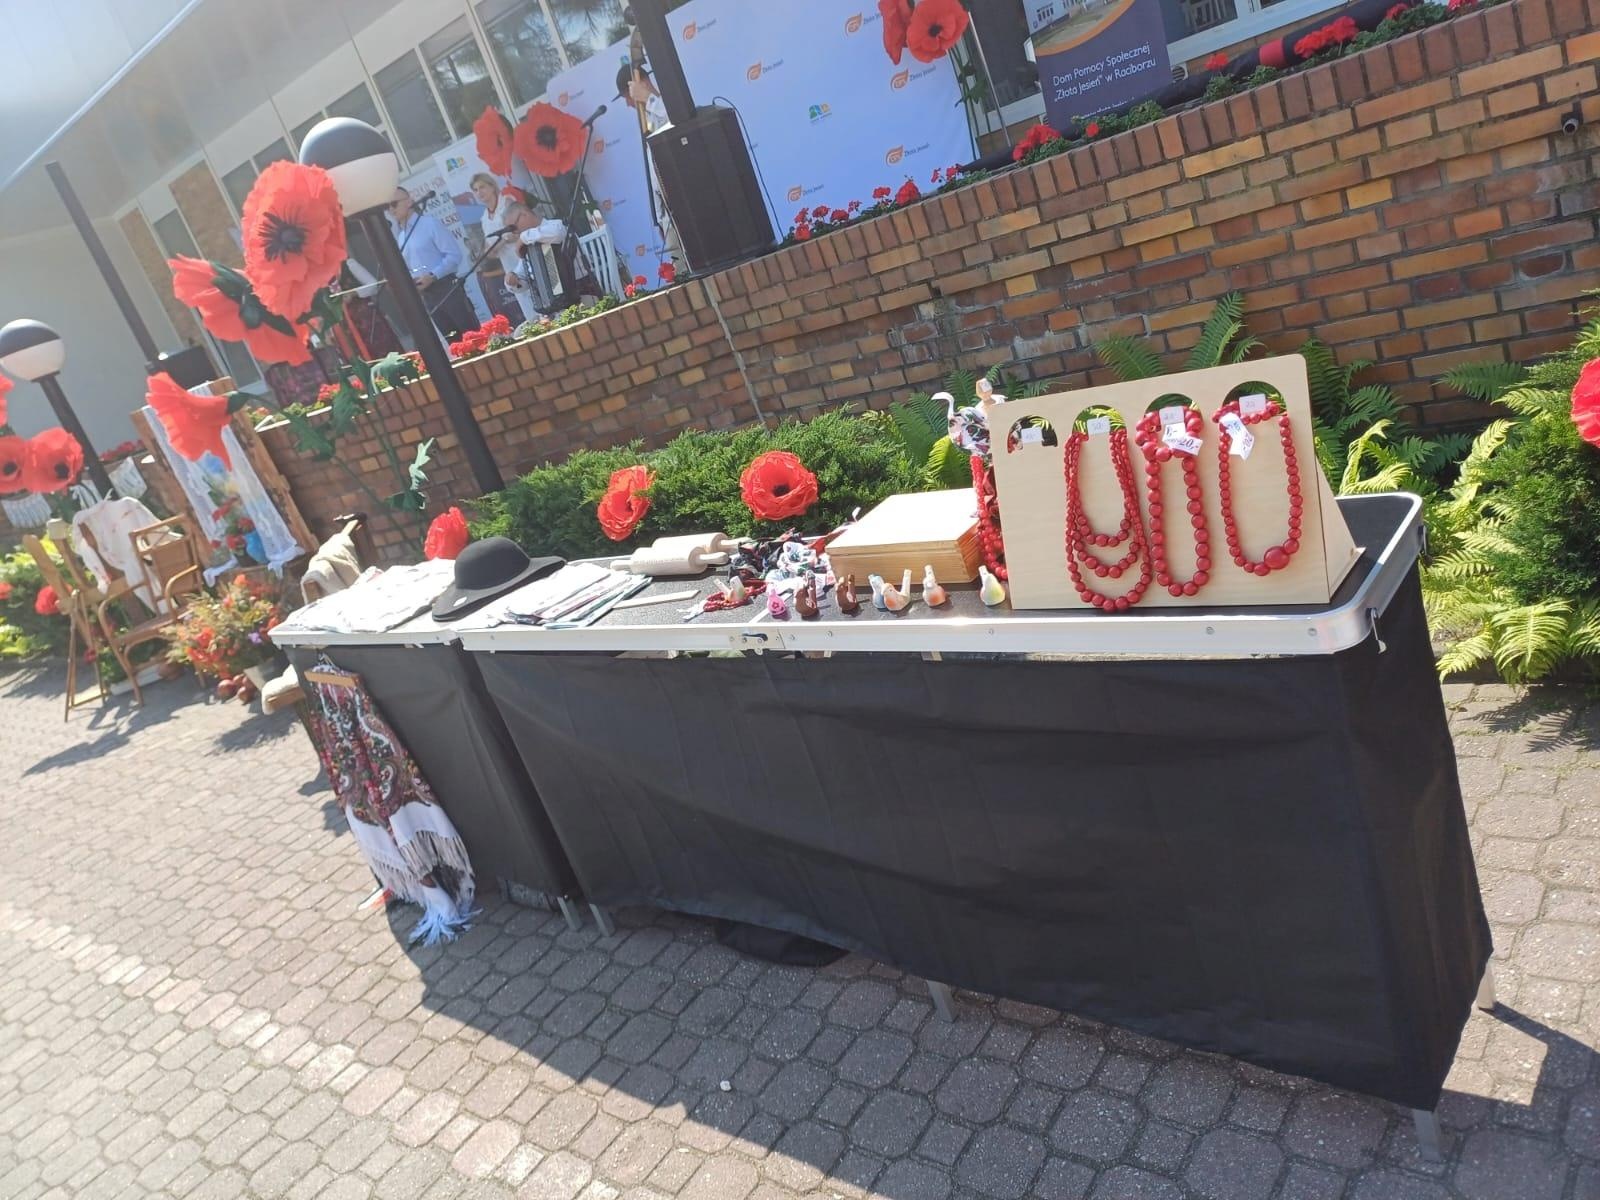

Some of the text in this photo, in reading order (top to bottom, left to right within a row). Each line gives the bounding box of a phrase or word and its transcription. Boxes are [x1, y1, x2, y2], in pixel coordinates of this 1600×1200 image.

[1052, 73, 1073, 86] Dom
[1074, 60, 1105, 79] Pomocy
[1105, 74, 1113, 83] w
[1115, 58, 1156, 79] Raciborzu
